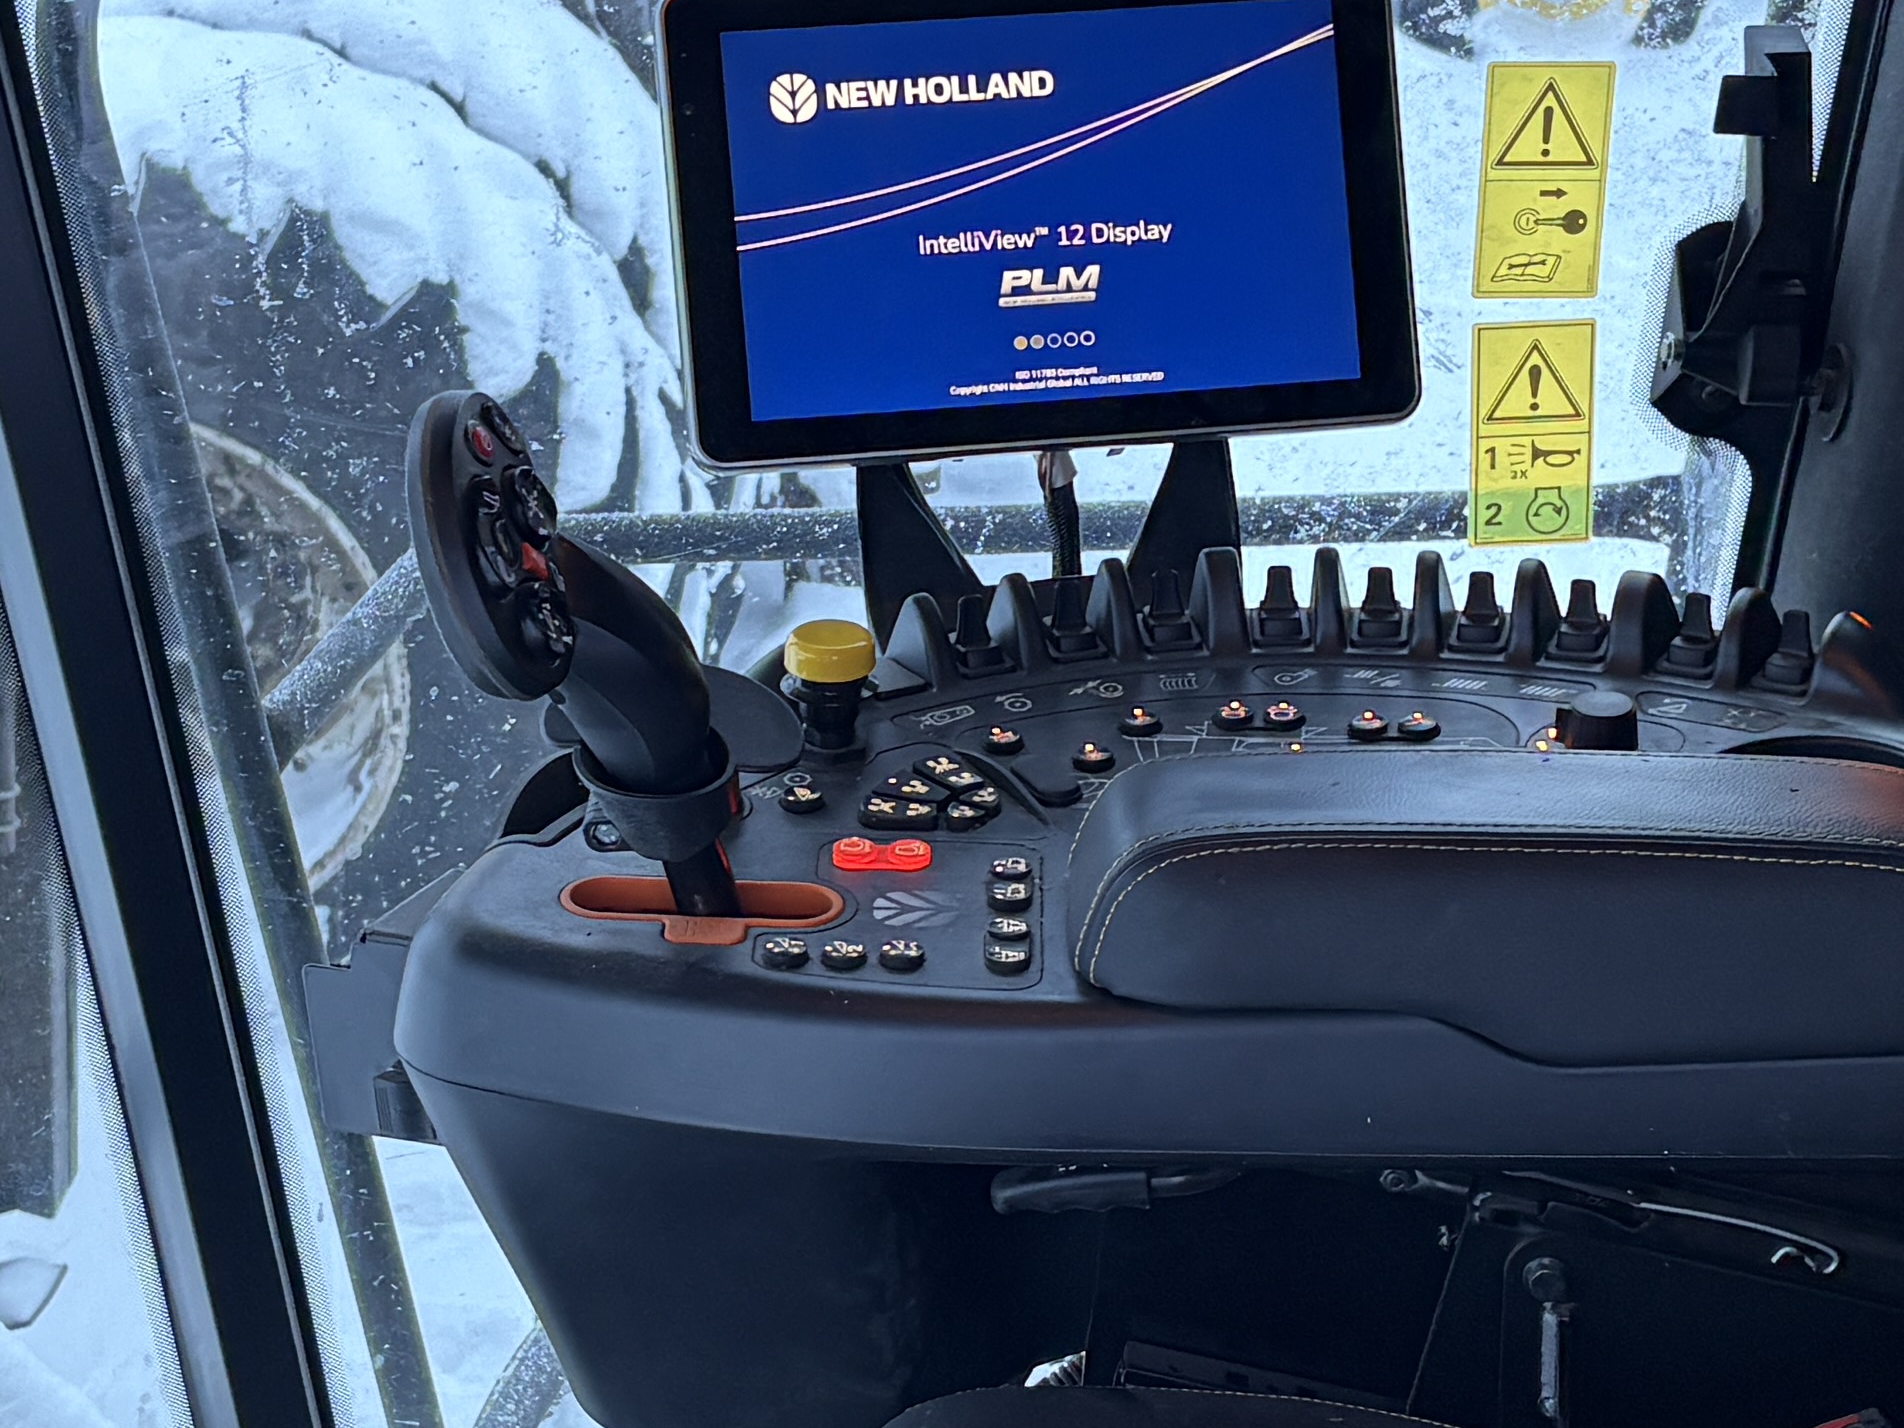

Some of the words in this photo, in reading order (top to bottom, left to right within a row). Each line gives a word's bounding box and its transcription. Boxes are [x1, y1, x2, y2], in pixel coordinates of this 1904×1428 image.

[825, 79, 898, 109] NEW
[903, 70, 1054, 105] HOLLAND
[1057, 224, 1086, 246] 12
[1091, 220, 1172, 246] Display
[1000, 264, 1101, 295] PLM
[1073, 375, 1088, 386] ALL
[1484, 446, 1496, 470] 1
[1484, 503, 1503, 526] 2
